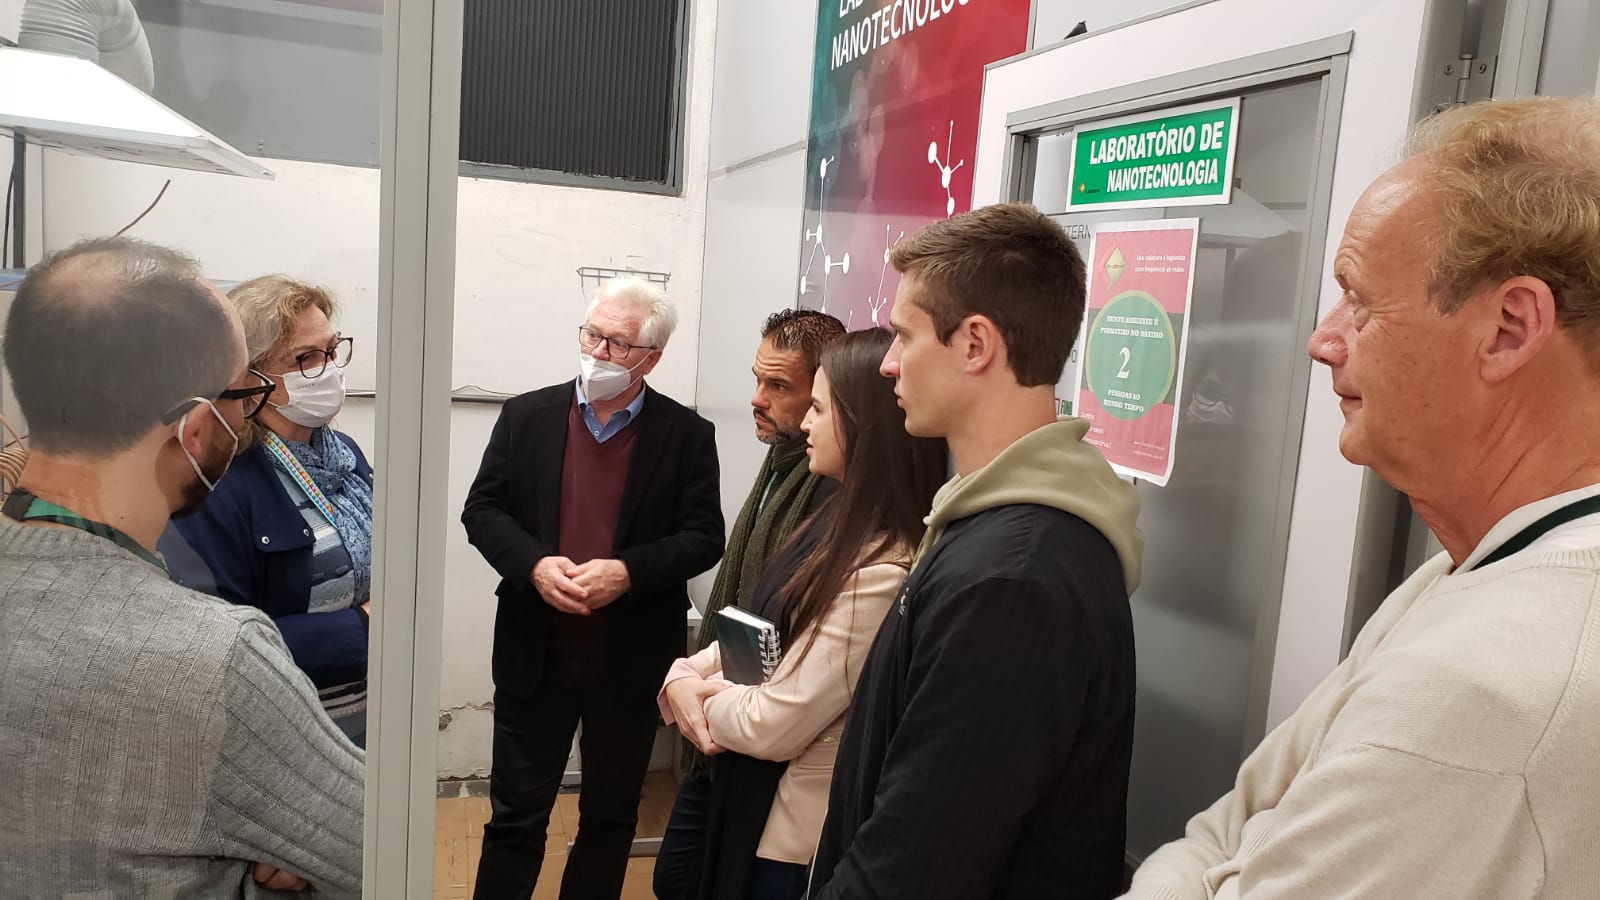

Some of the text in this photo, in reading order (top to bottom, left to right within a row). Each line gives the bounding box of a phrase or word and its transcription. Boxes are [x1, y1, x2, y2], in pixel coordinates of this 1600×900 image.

[831, 0, 969, 71] NANOTECNOL
[1089, 120, 1225, 165] LABORATÓRIO DE
[1106, 158, 1218, 192] NANOTECNOLOGIA
[1116, 346, 1131, 379] 2
[1124, 402, 1145, 413] TEMPO
